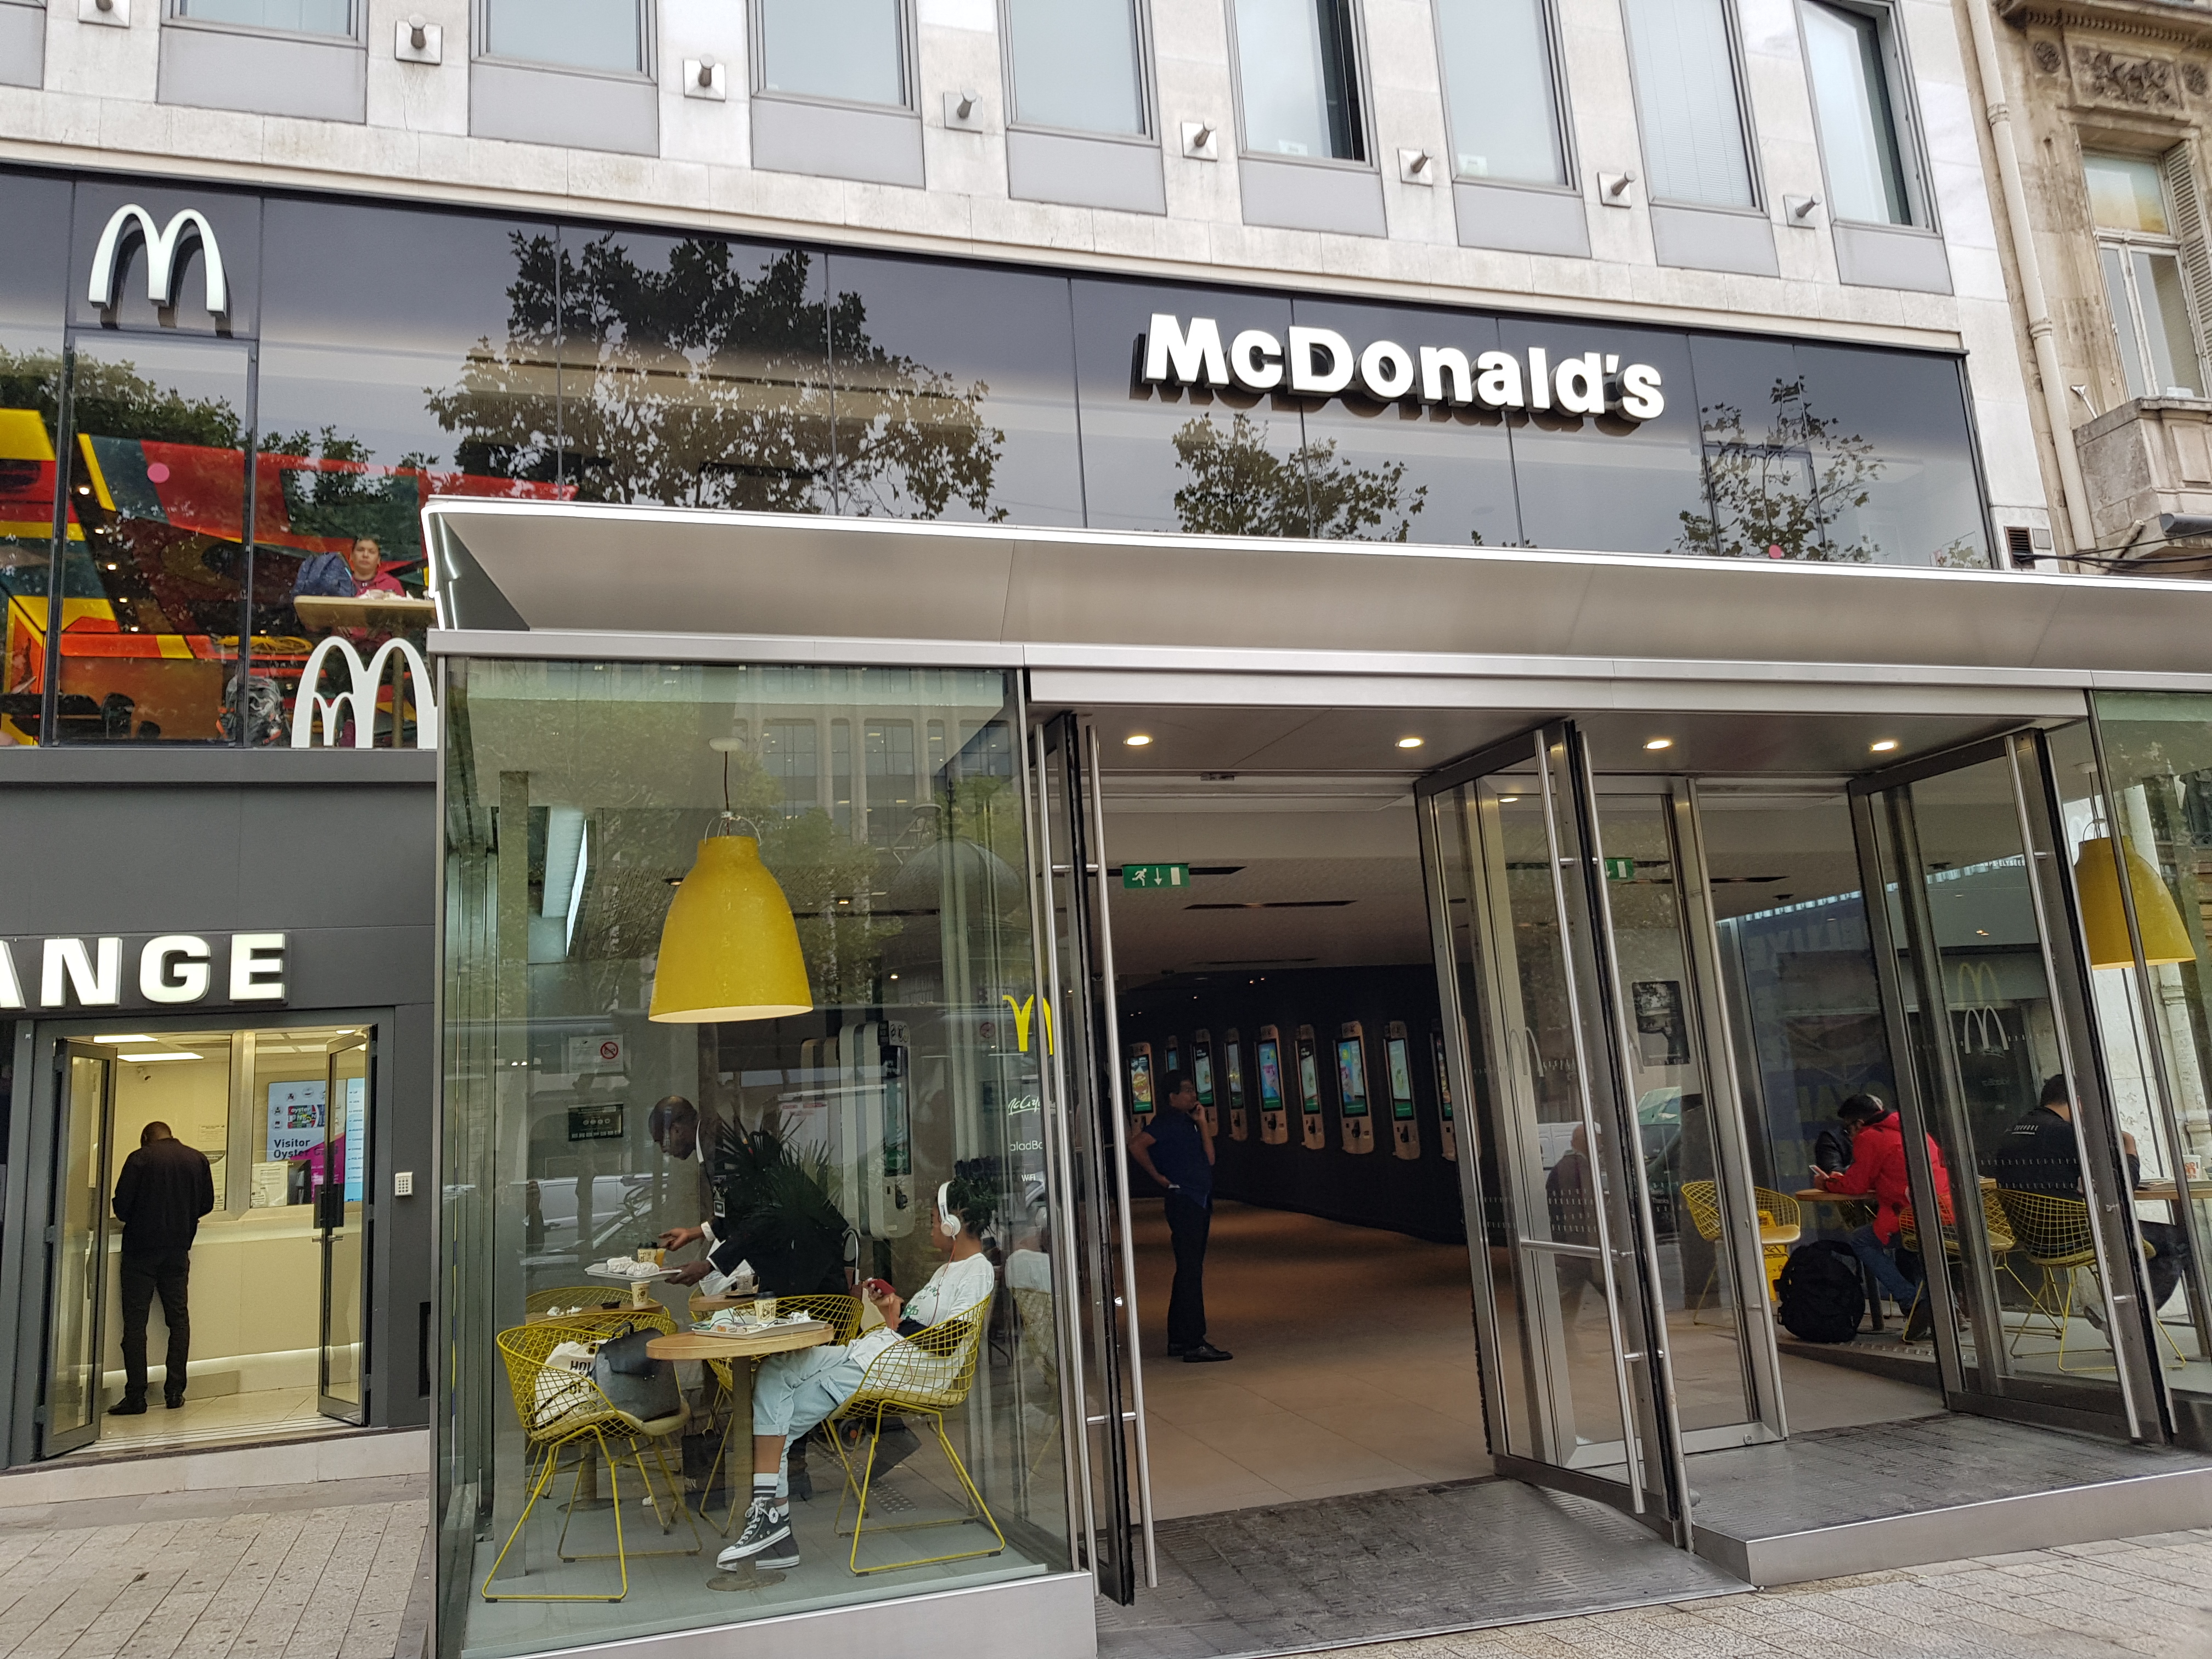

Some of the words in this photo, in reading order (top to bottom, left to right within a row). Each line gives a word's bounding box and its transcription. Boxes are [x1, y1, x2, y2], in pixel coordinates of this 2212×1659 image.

[1143, 313, 1666, 422] McDonald's
[274, 1138, 311, 1148] Visitor
[273, 1149, 309, 1160] Oyster
